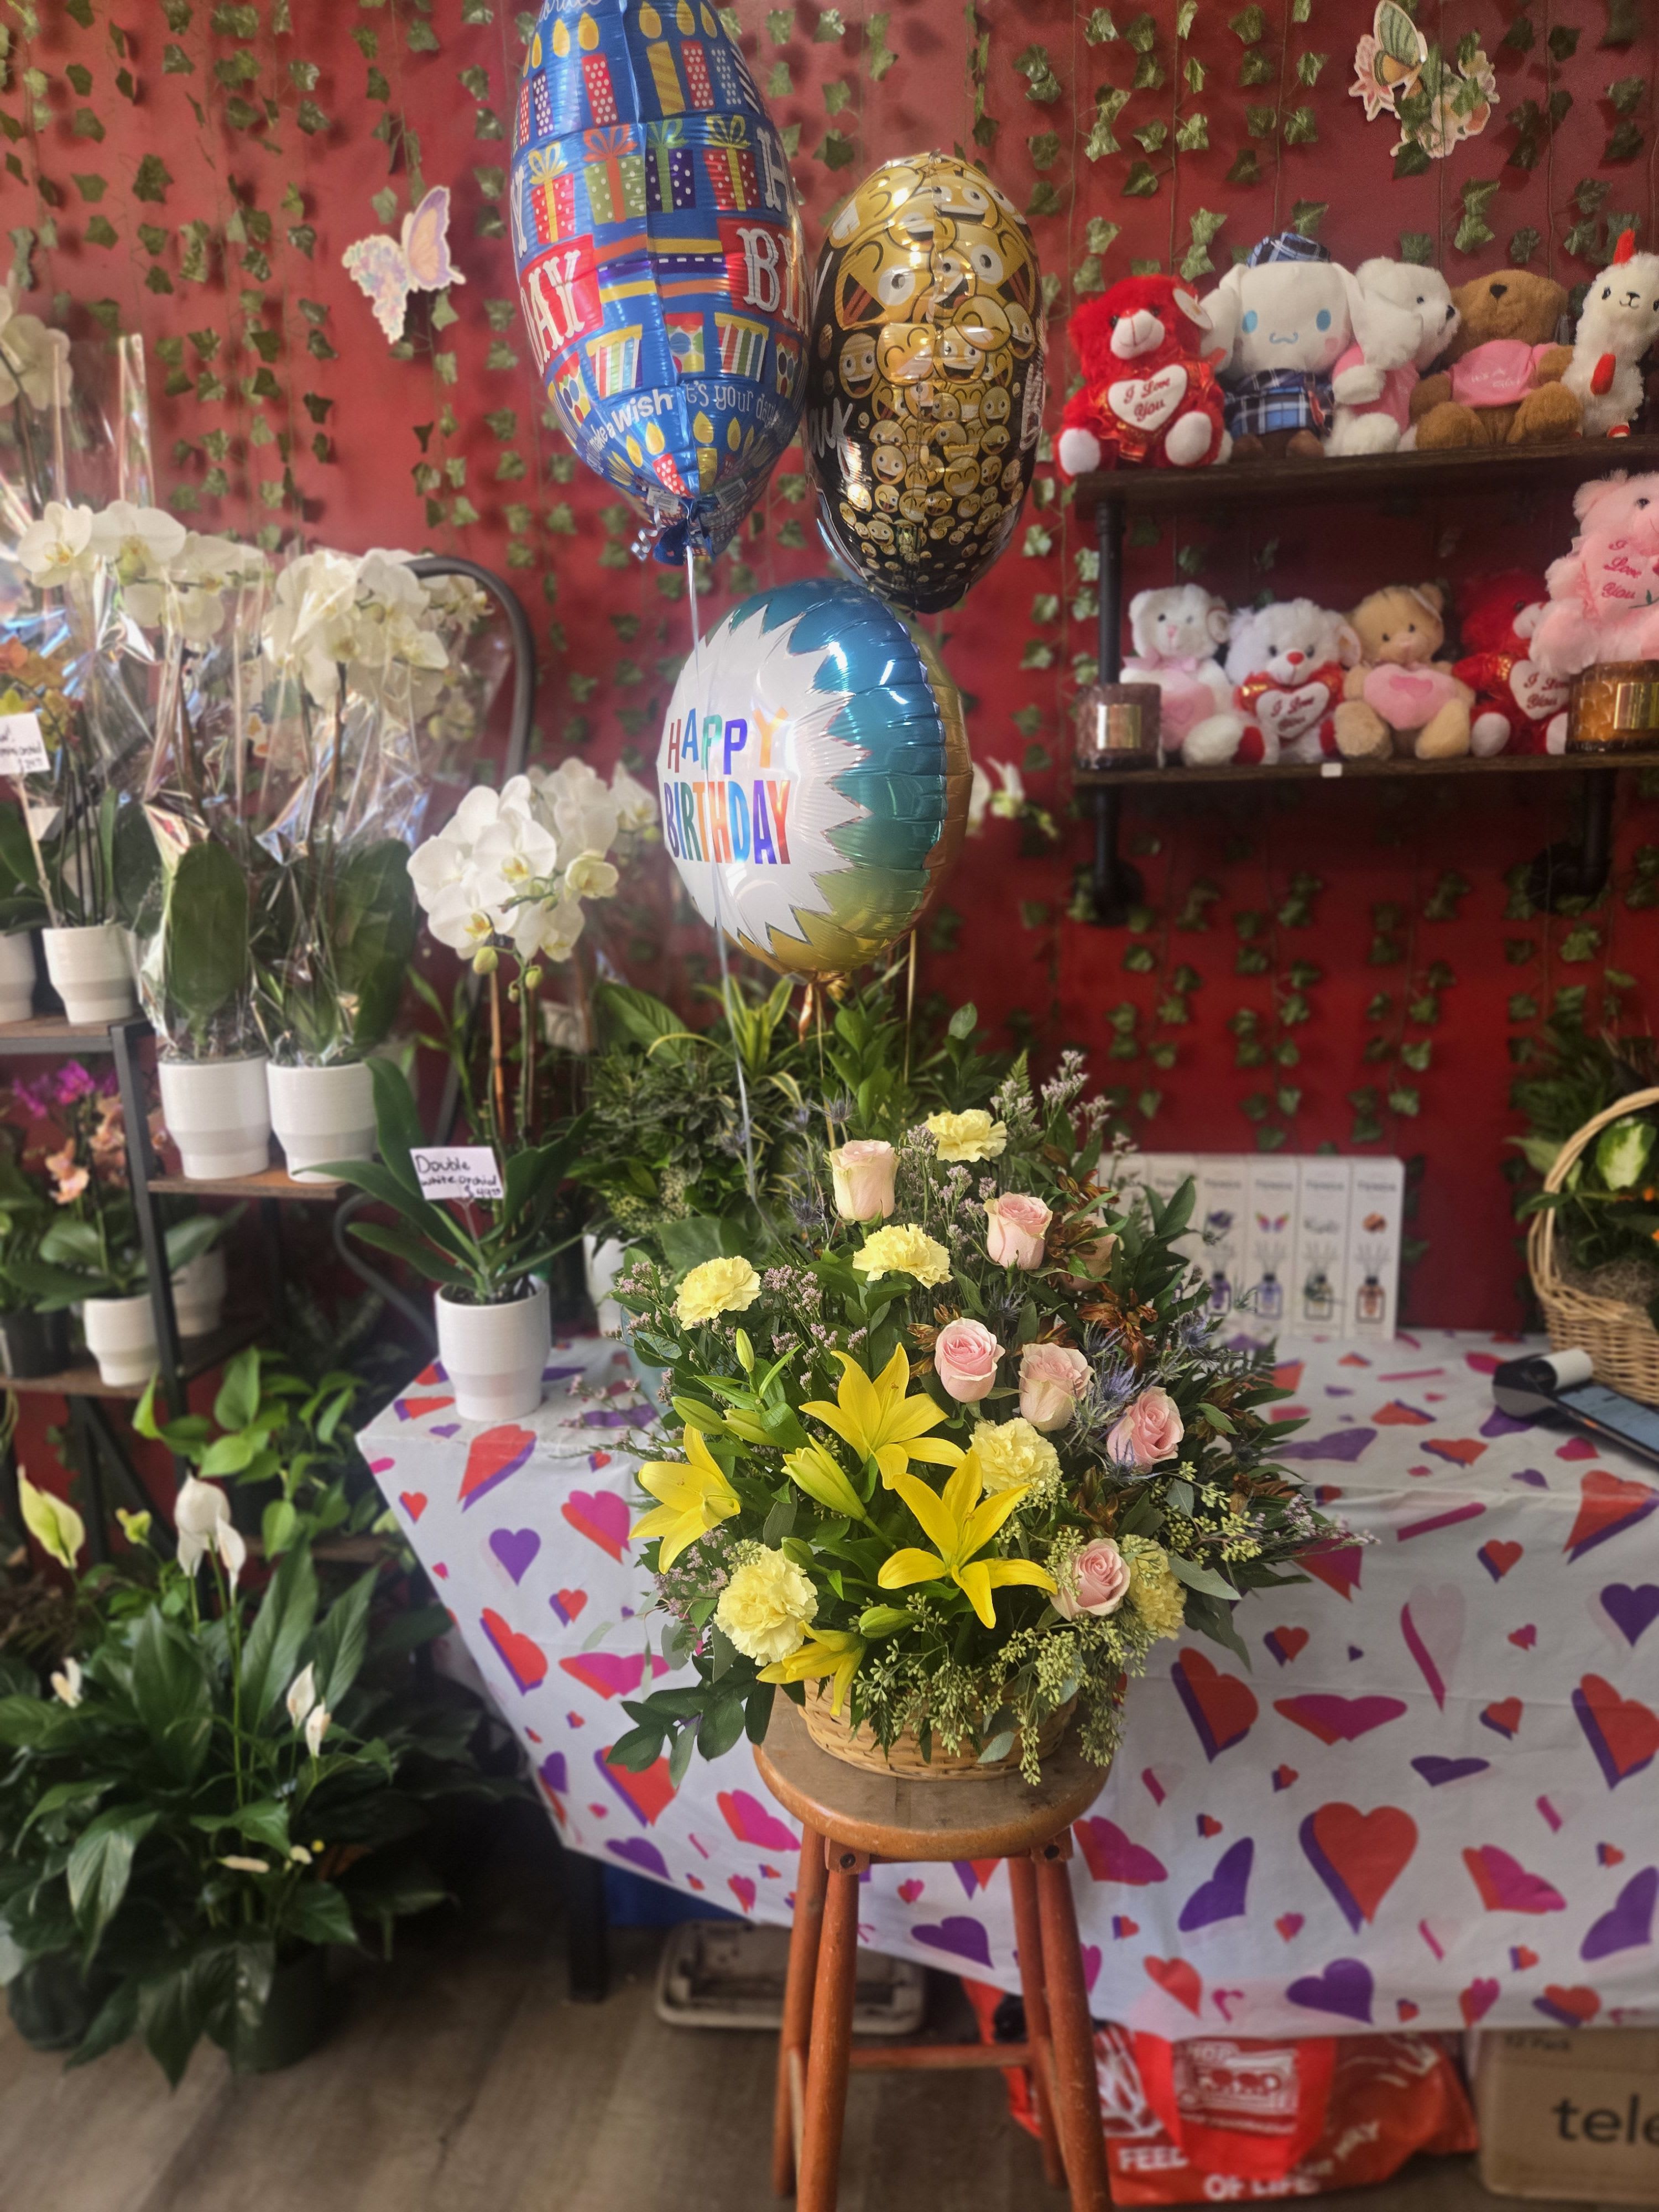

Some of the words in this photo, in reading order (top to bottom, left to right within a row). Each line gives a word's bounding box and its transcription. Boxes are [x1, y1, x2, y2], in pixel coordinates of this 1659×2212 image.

[714, 385, 754, 411] your
[1123, 385, 1135, 404] I
[1141, 378, 1170, 398] Love
[611, 389, 673, 434] wish
[1134, 399, 1165, 422] You
[607, 422, 617, 439] a
[1603, 557, 1642, 578] Love
[1601, 582, 1635, 599] You
[1524, 672, 1540, 688] I
[1287, 696, 1314, 714] Love
[1527, 693, 1558, 709] You
[667, 705, 789, 775] HAPPY
[664, 780, 791, 865] BIRTHDAY
[415, 1154, 471, 1173] Double
[1118, 2145, 1189, 2171] FEEL
[1203, 2173, 1244, 2200] OF
